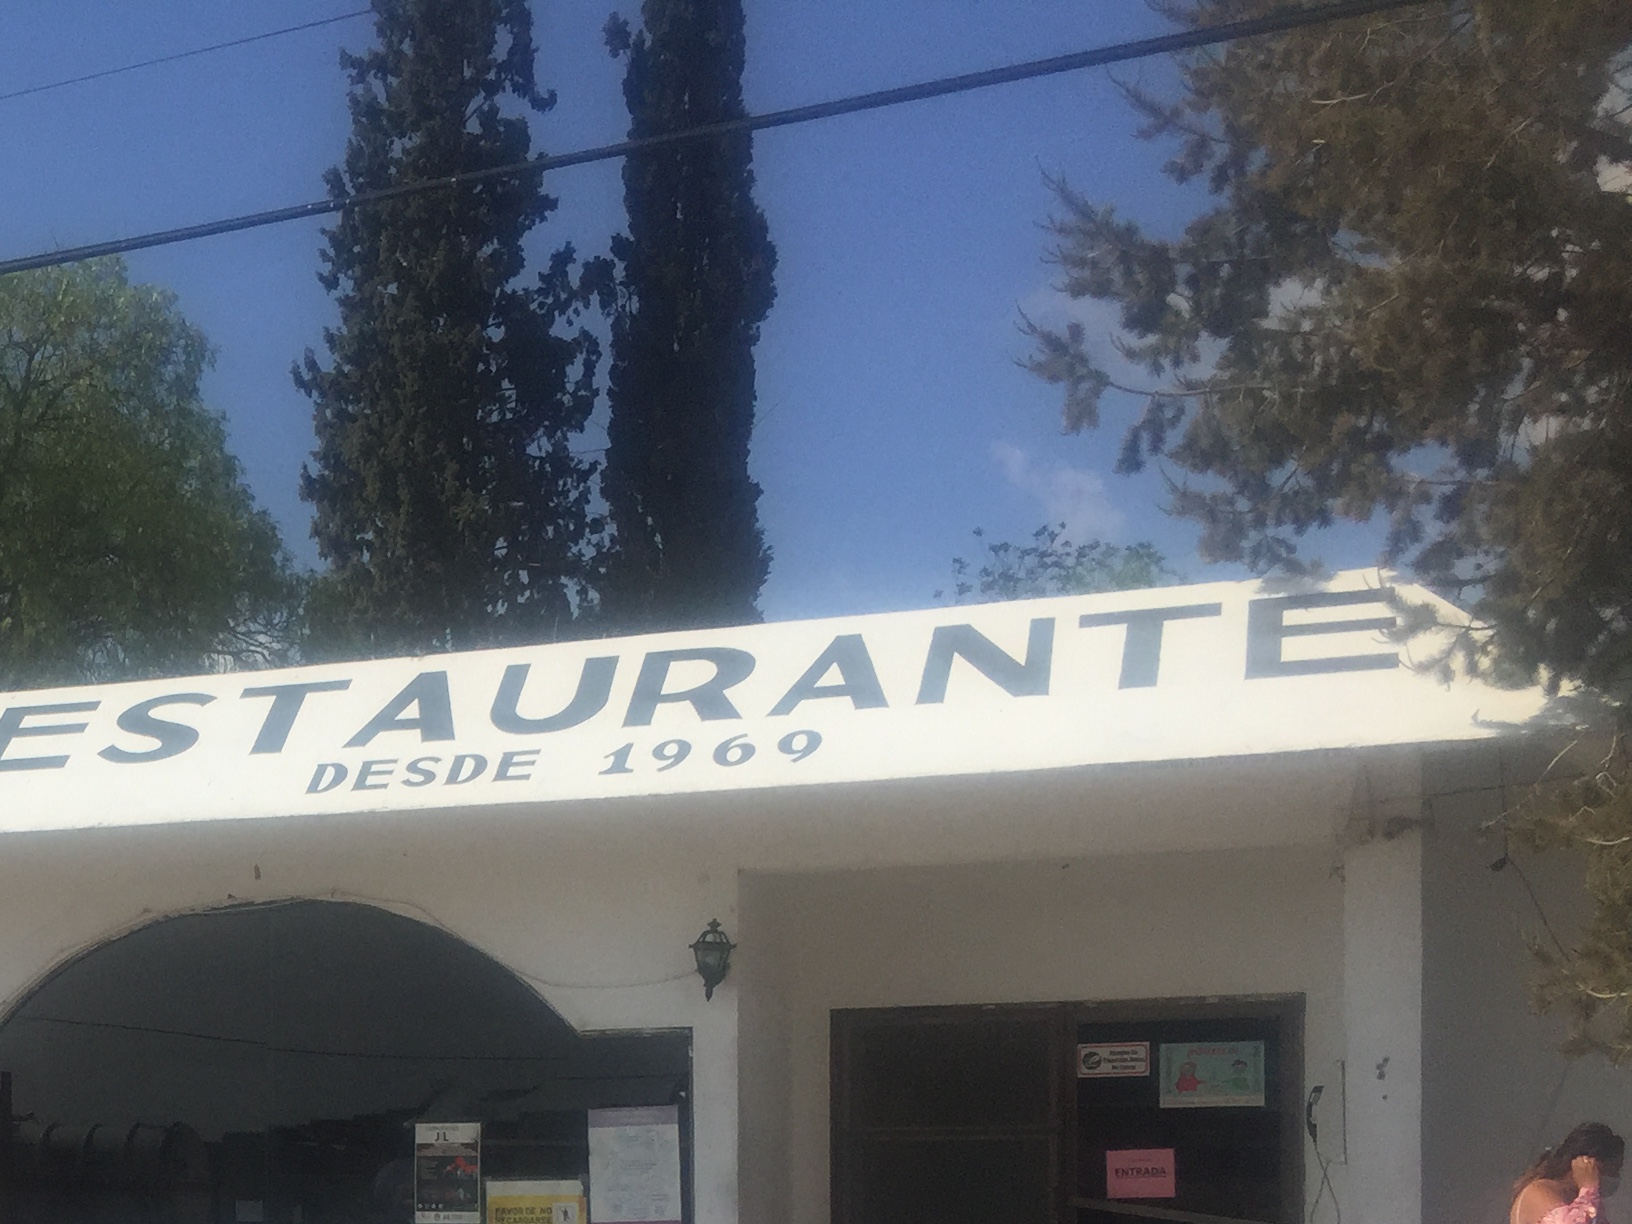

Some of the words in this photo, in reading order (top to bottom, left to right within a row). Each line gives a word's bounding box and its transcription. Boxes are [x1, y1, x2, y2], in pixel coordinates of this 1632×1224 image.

[305, 748, 542, 795] DESDE
[597, 728, 824, 776] 1969
[1114, 1167, 1167, 1178] ENTRADA
